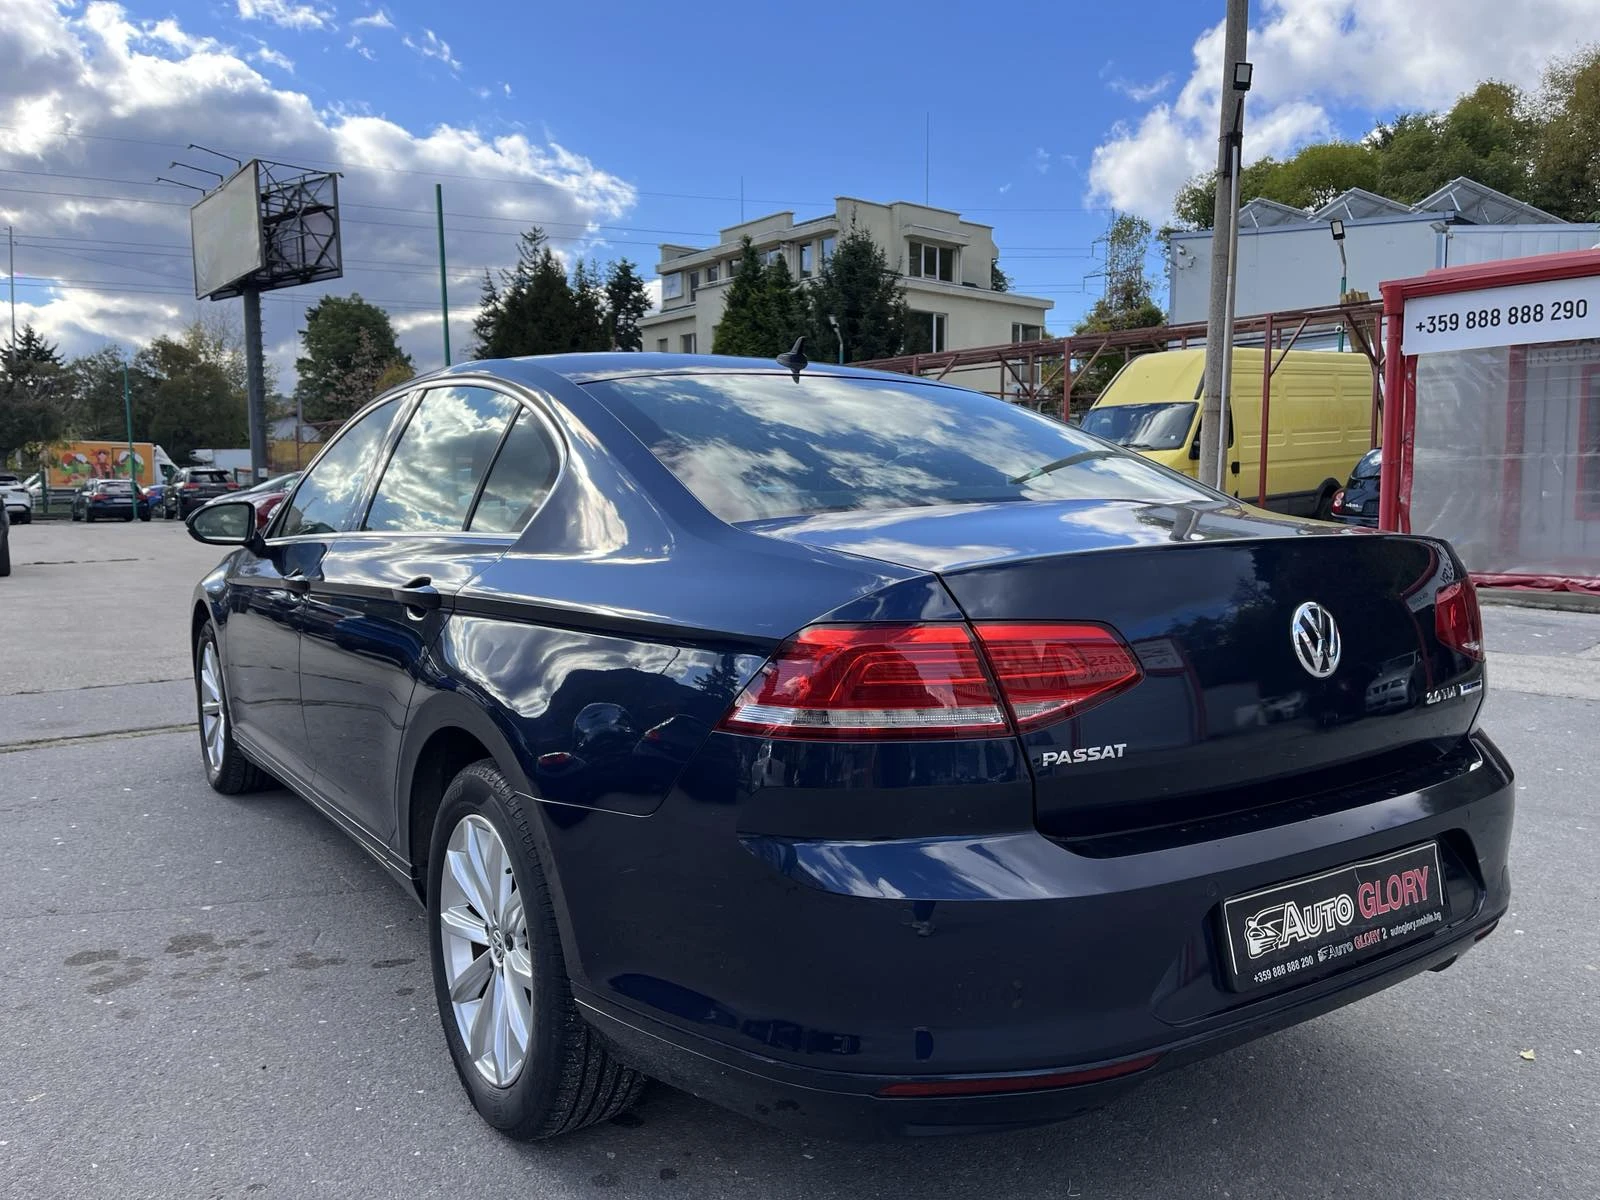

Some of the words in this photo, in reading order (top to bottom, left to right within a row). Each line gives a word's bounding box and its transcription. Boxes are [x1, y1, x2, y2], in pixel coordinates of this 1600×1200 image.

[1416, 313, 1459, 334] +359
[1466, 308, 1501, 329] 888
[1508, 303, 1544, 325] 888
[1551, 299, 1588, 320] 290
[1042, 743, 1127, 767] PASSAT
[1358, 866, 1429, 919] GLORY
[1253, 969, 1272, 983] +359
[1273, 964, 1286, 978] 888
[1286, 960, 1300, 973] 888
[1300, 955, 1314, 968] 290
[1354, 928, 1381, 950] GLORY
[1382, 927, 1388, 940] 2
[1390, 911, 1442, 937] autoglory.mobile.bg
